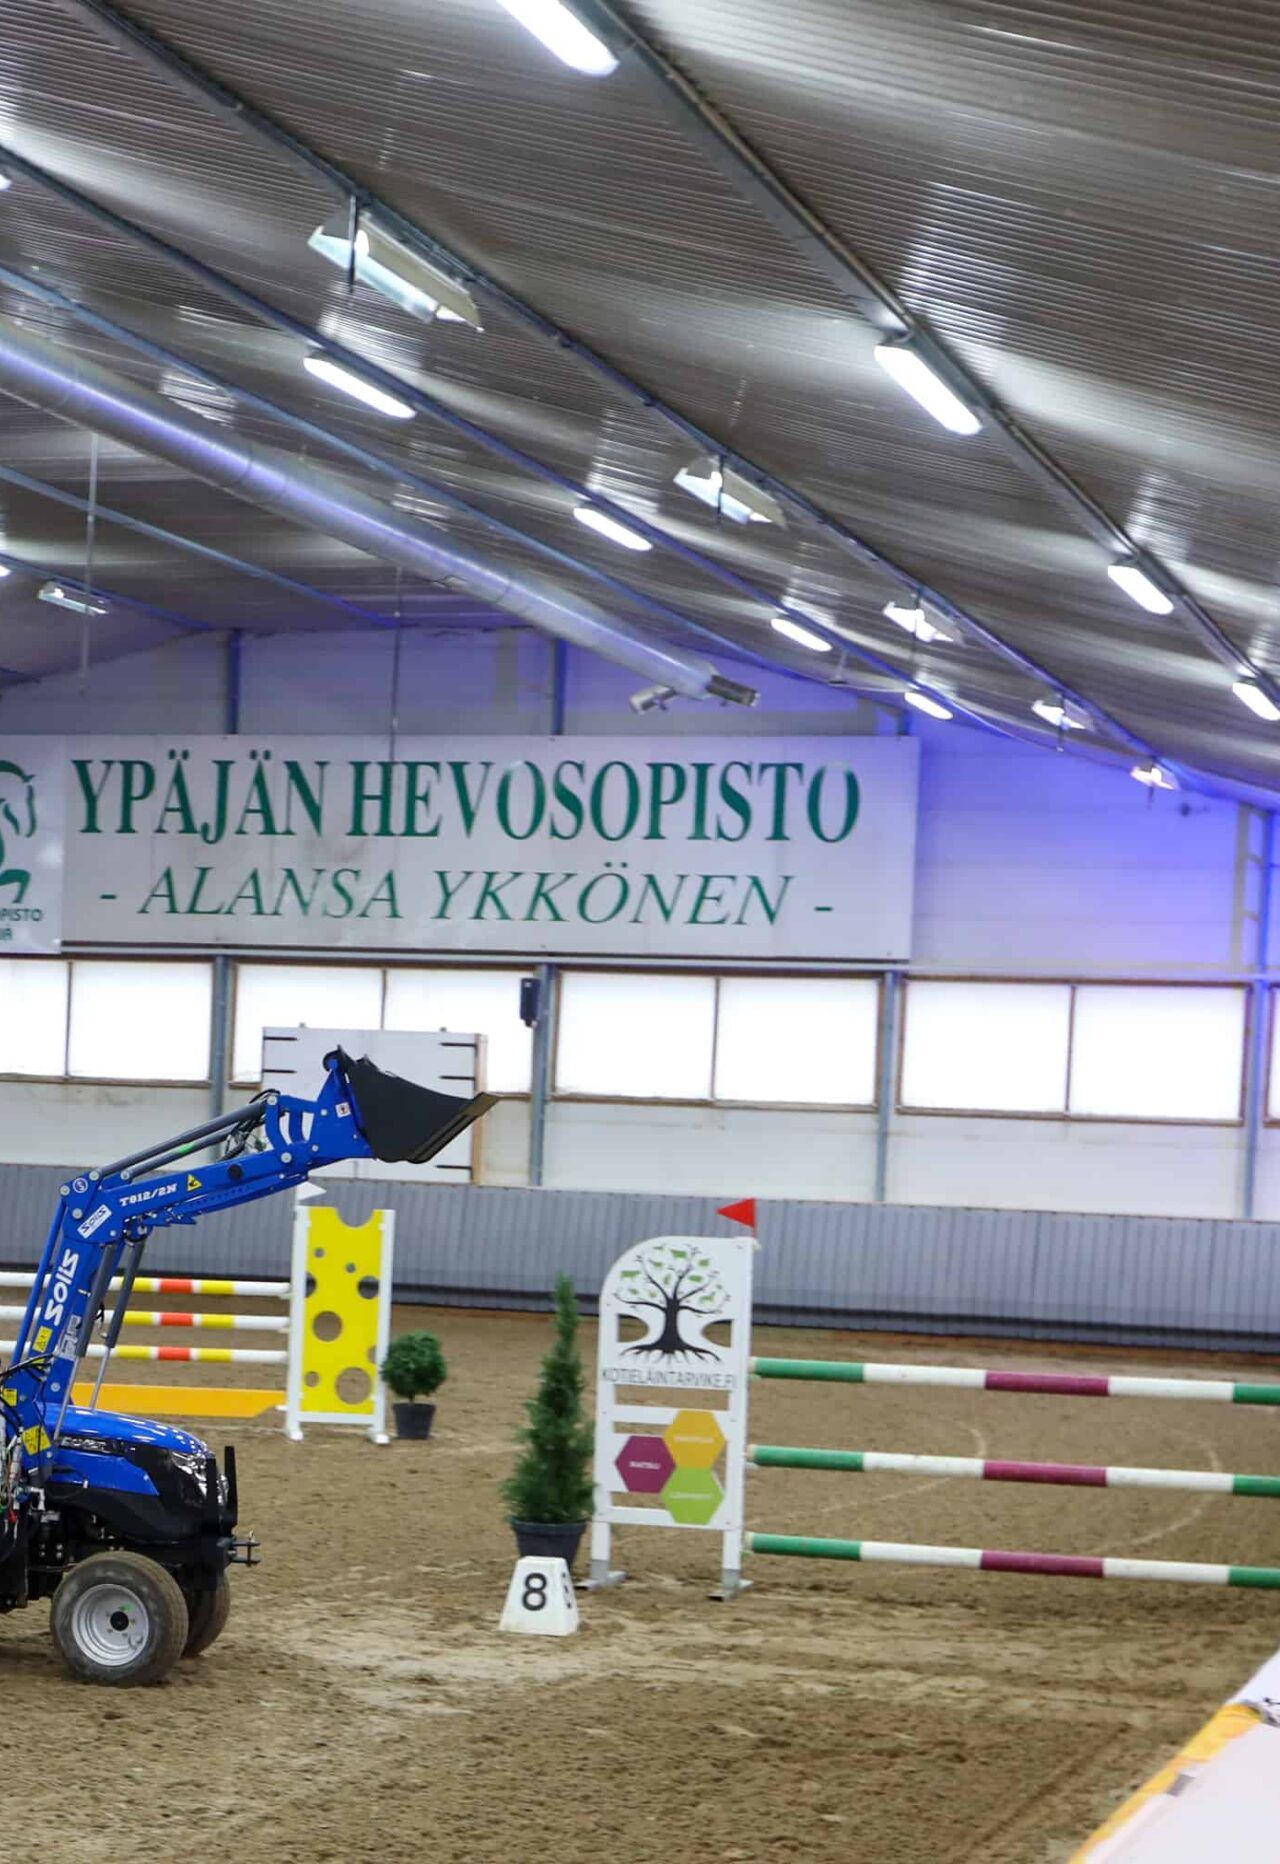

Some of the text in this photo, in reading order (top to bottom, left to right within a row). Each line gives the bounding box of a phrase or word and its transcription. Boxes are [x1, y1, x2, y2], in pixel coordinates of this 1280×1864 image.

[72, 750, 861, 844] YPÄJÄN HEVOSOPISTO
[136, 866, 404, 919] ALANSA
[431, 861, 795, 926] YKKÖNEN
[522, 1572, 548, 1611] 8
